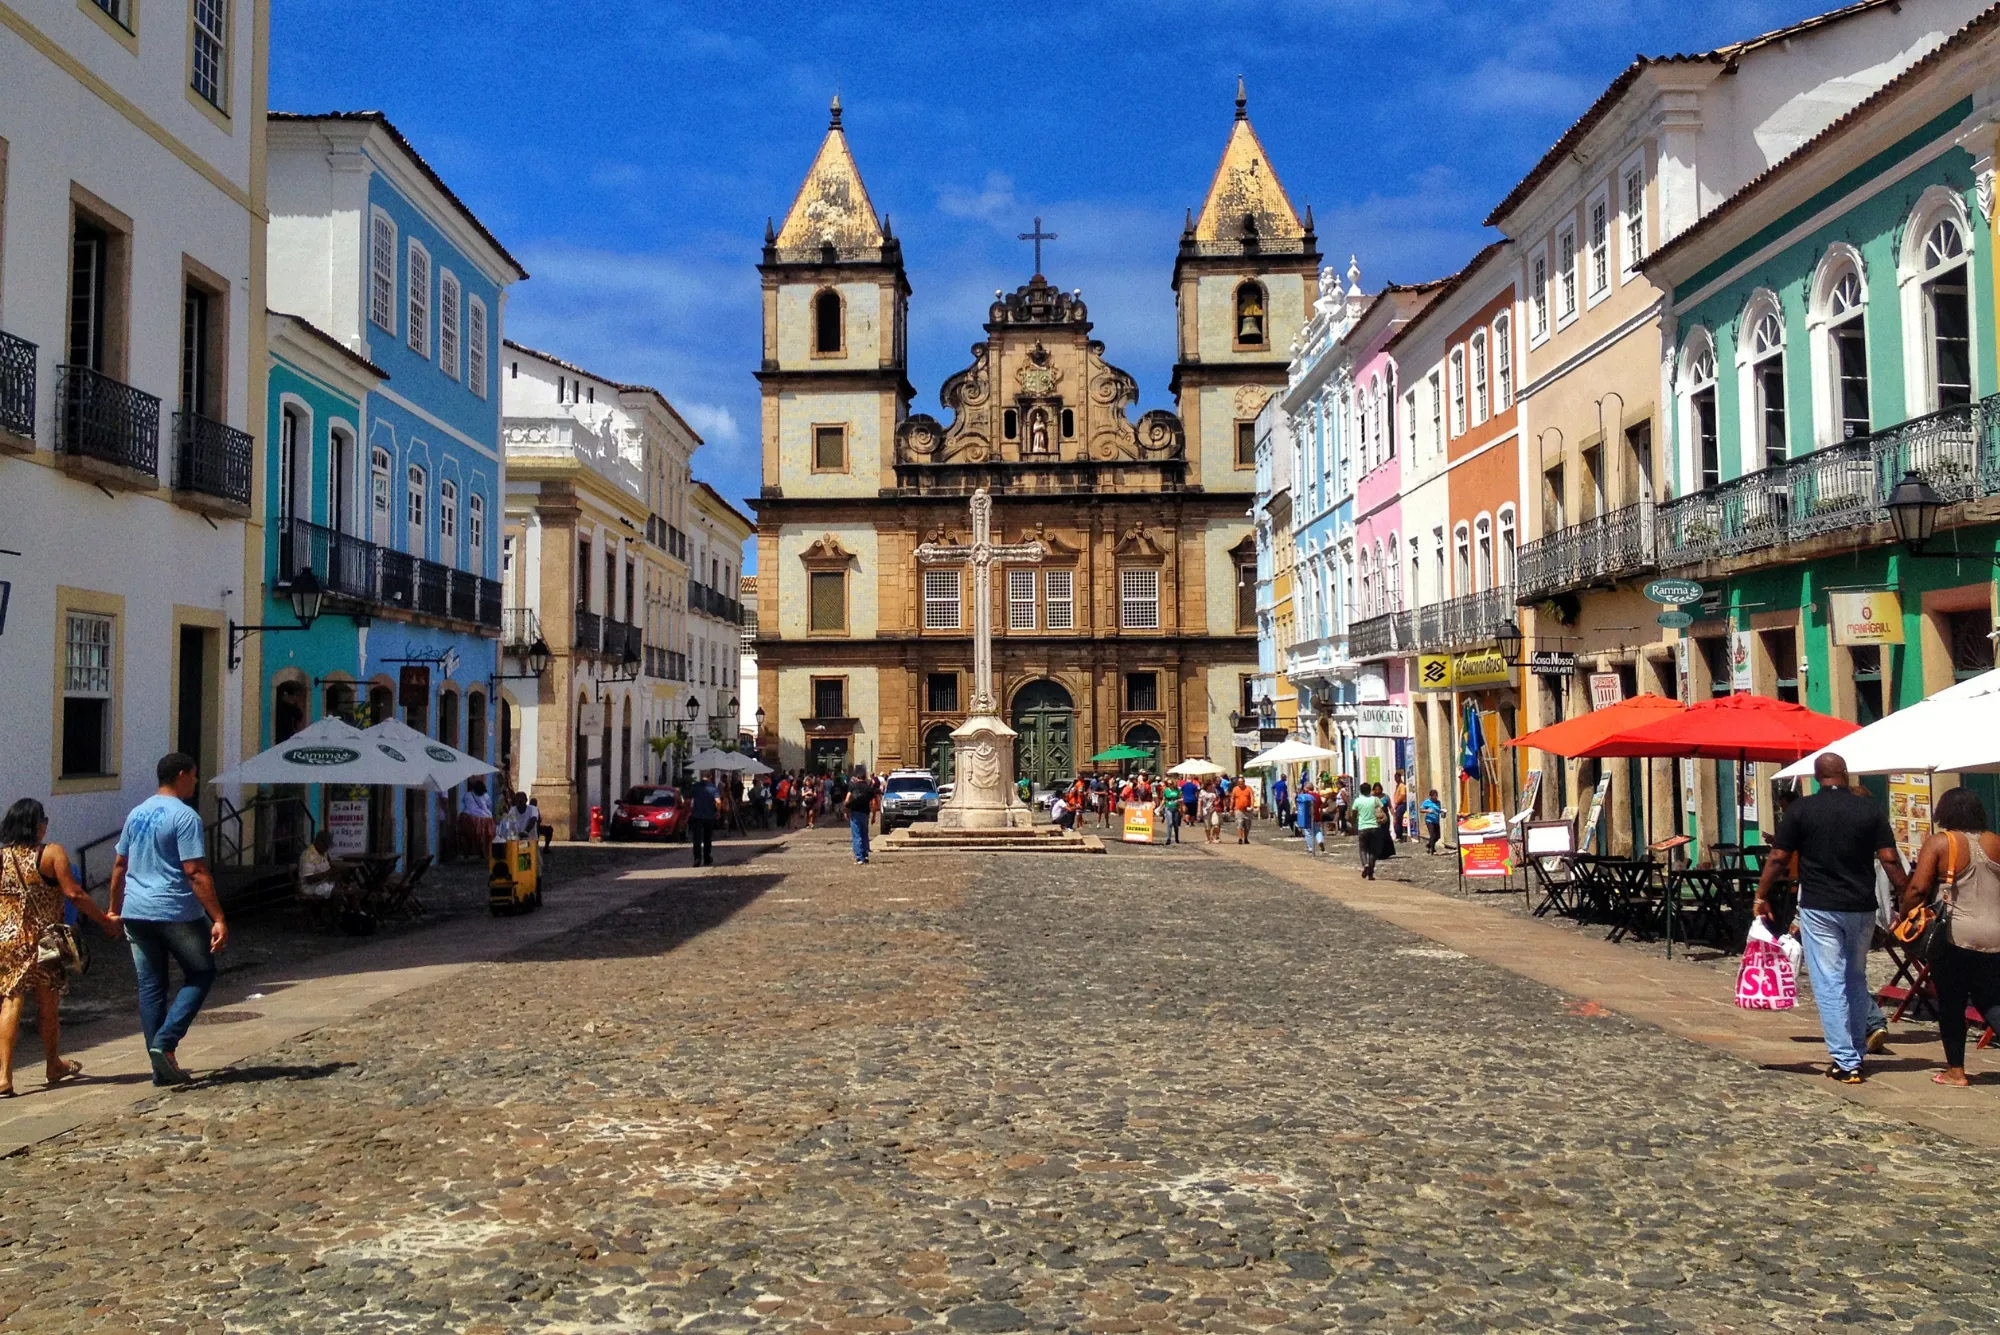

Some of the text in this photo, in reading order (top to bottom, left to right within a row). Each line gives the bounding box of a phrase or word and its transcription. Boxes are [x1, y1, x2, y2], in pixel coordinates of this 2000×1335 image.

[1652, 585, 1688, 596] Ramma
[1551, 652, 1574, 665] Nossa
[1462, 660, 1479, 677] BANCO
[1486, 656, 1505, 674] BRASIL
[1560, 666, 1573, 674] ARTE
[1363, 710, 1404, 722] ADVOCATUS
[293, 751, 341, 760] Ramma
[333, 803, 361, 811] Sale
